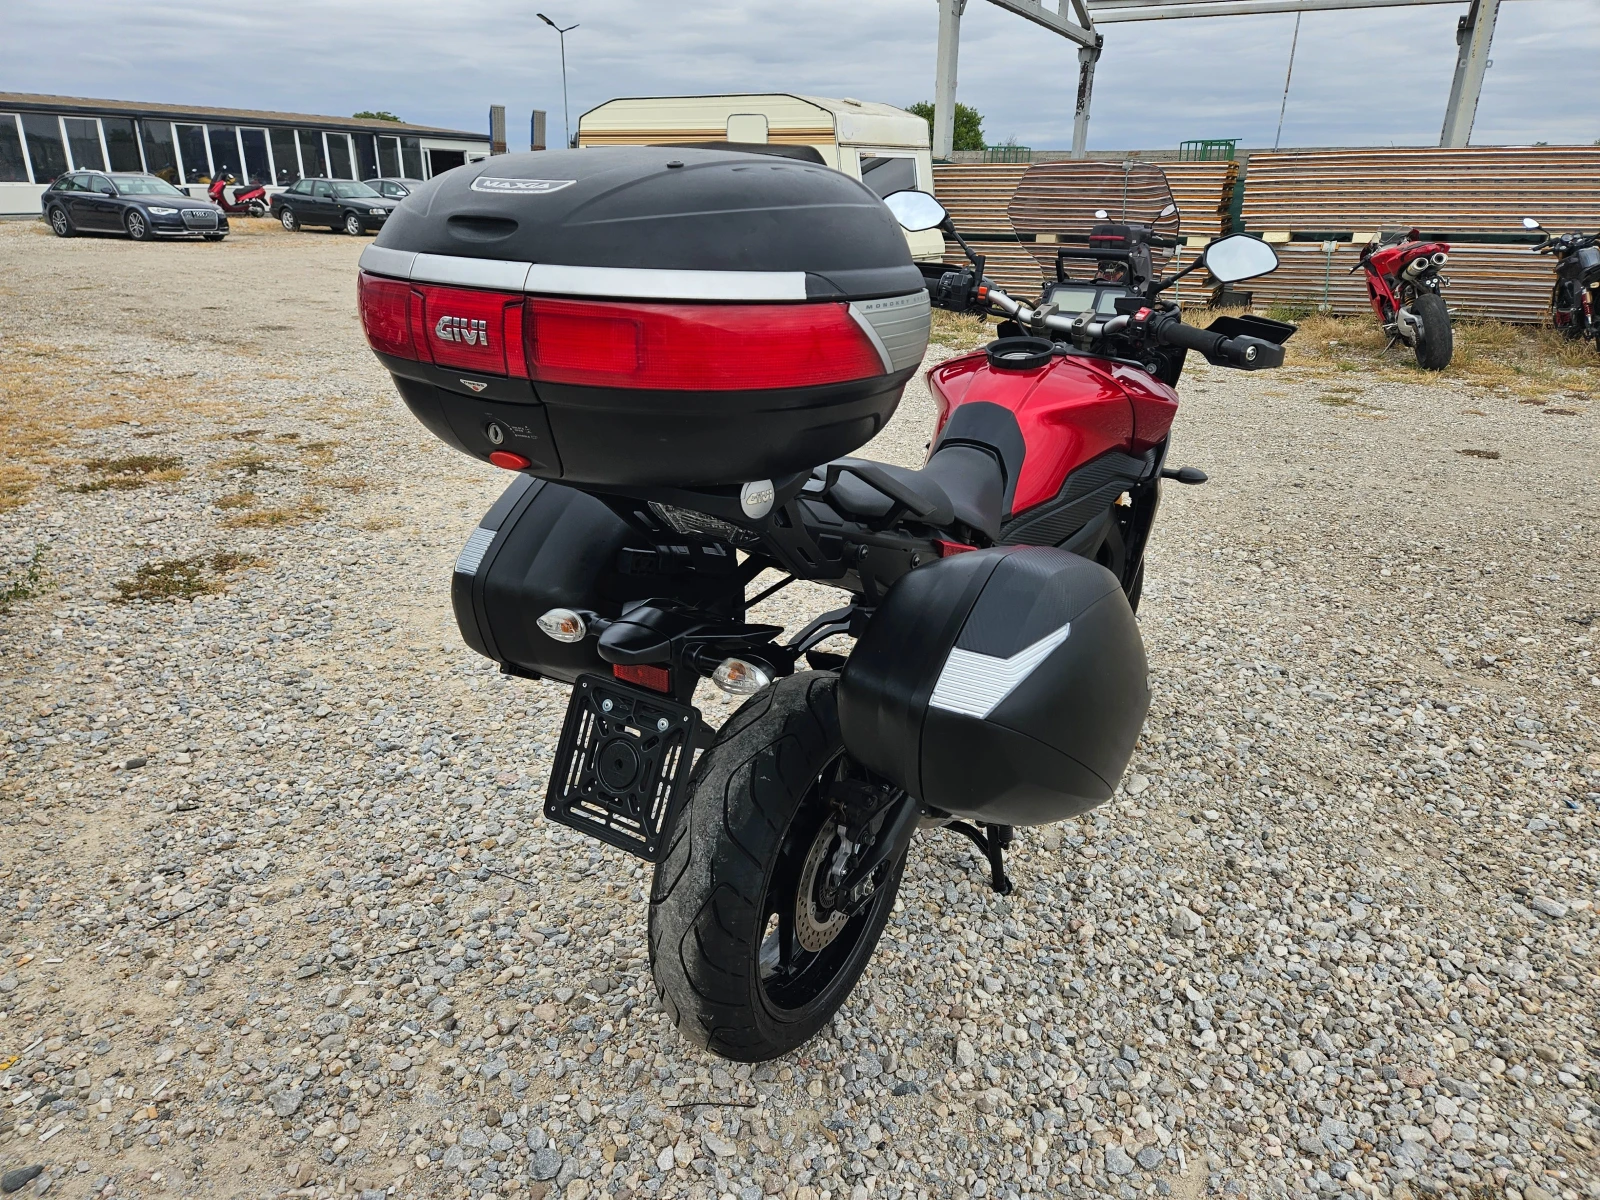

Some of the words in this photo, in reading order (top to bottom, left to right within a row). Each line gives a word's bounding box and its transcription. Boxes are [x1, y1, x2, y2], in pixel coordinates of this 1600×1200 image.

[483, 180, 550, 189] MAXIA
[435, 316, 488, 346] GIVI
[746, 489, 773, 505] GIVI
